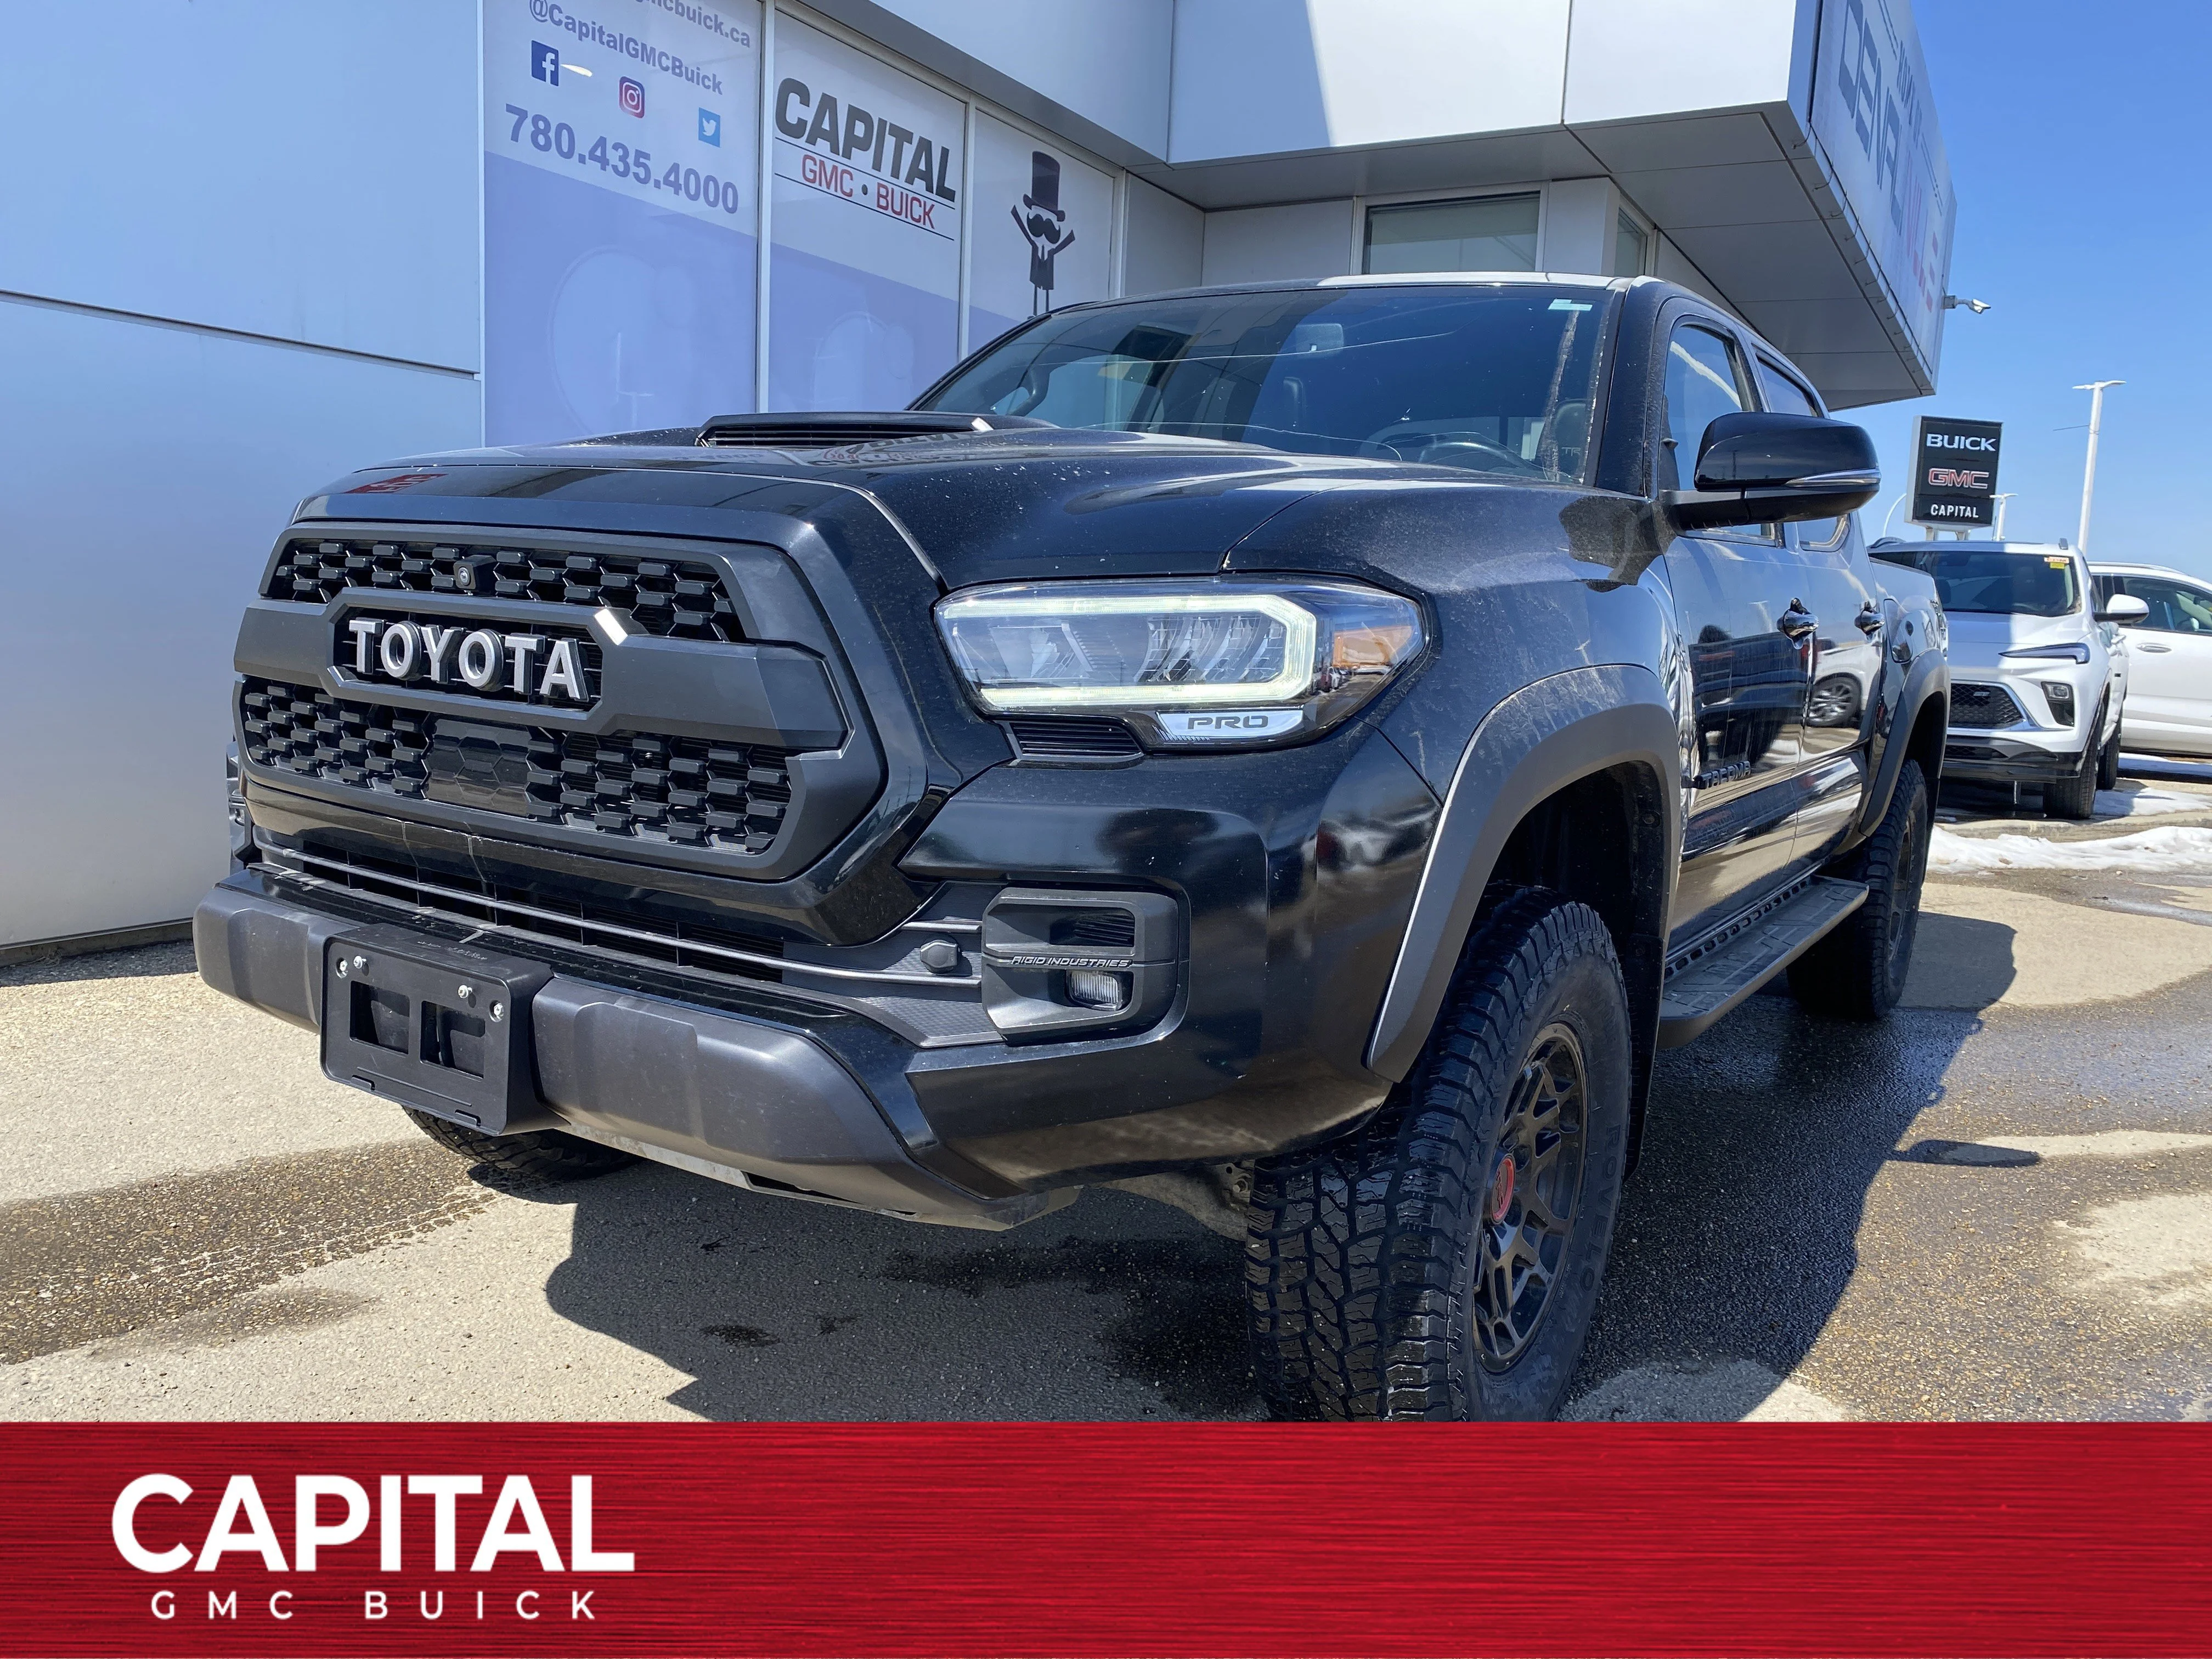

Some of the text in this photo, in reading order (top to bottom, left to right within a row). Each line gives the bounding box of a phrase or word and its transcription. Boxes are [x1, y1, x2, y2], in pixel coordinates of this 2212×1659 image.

[529, 0, 723, 95] @CapitalGMCBuick
[635, 0, 751, 48] cbuick.ca
[505, 103, 738, 214] 780.435.4000
[775, 77, 956, 202] CAPITAL
[802, 154, 935, 229] GMC BUICK
[1926, 433, 1996, 452] BUICK
[1928, 467, 1989, 489] GMC
[1931, 504, 1979, 518] CAPITAL
[349, 617, 589, 702] TOYOTA
[1187, 715, 1268, 730] PRO
[1011, 956, 1133, 968] RIGID INDUSTRIES
[1580, 1124, 1621, 1291] ROVELO
